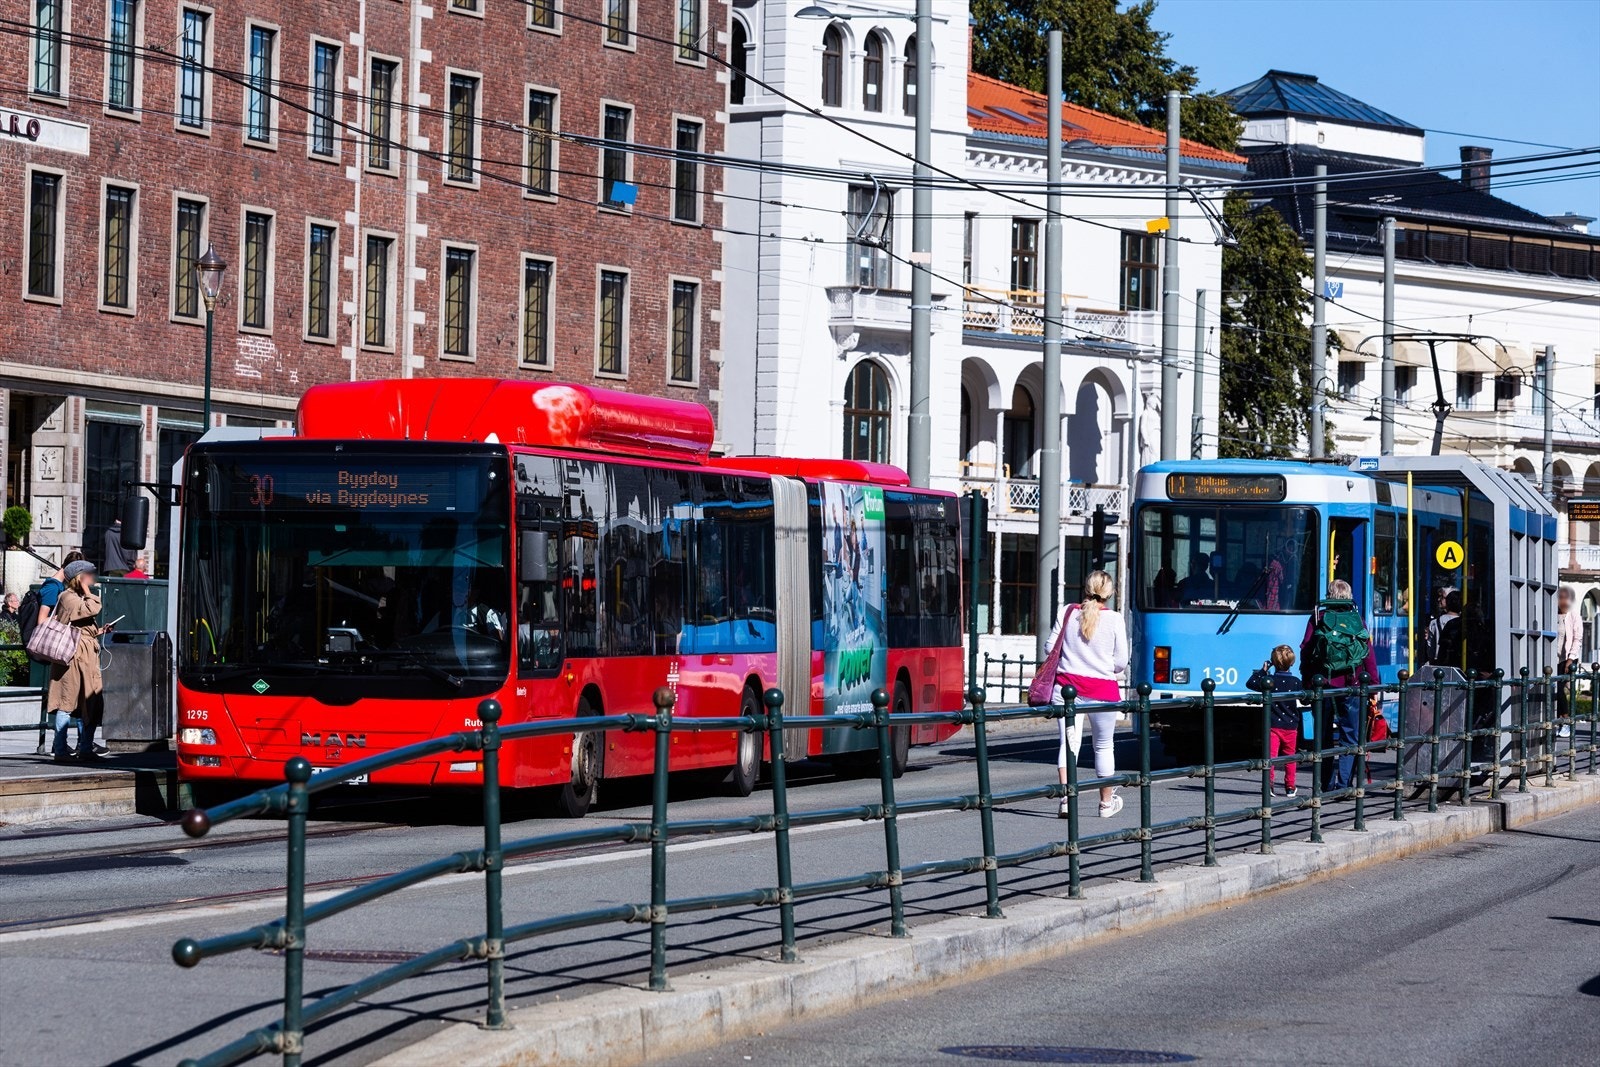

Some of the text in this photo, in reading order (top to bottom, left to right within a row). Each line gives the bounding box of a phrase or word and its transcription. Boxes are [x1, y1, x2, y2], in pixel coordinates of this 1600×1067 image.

[0, 113, 41, 138] RO
[338, 470, 398, 488] Bygdøy
[250, 474, 274, 505] 30
[306, 489, 429, 507] via Bygdøynes
[1443, 546, 1457, 563] A
[1203, 667, 1238, 685] 130
[186, 709, 208, 720] 1295
[301, 732, 367, 748] MAN
